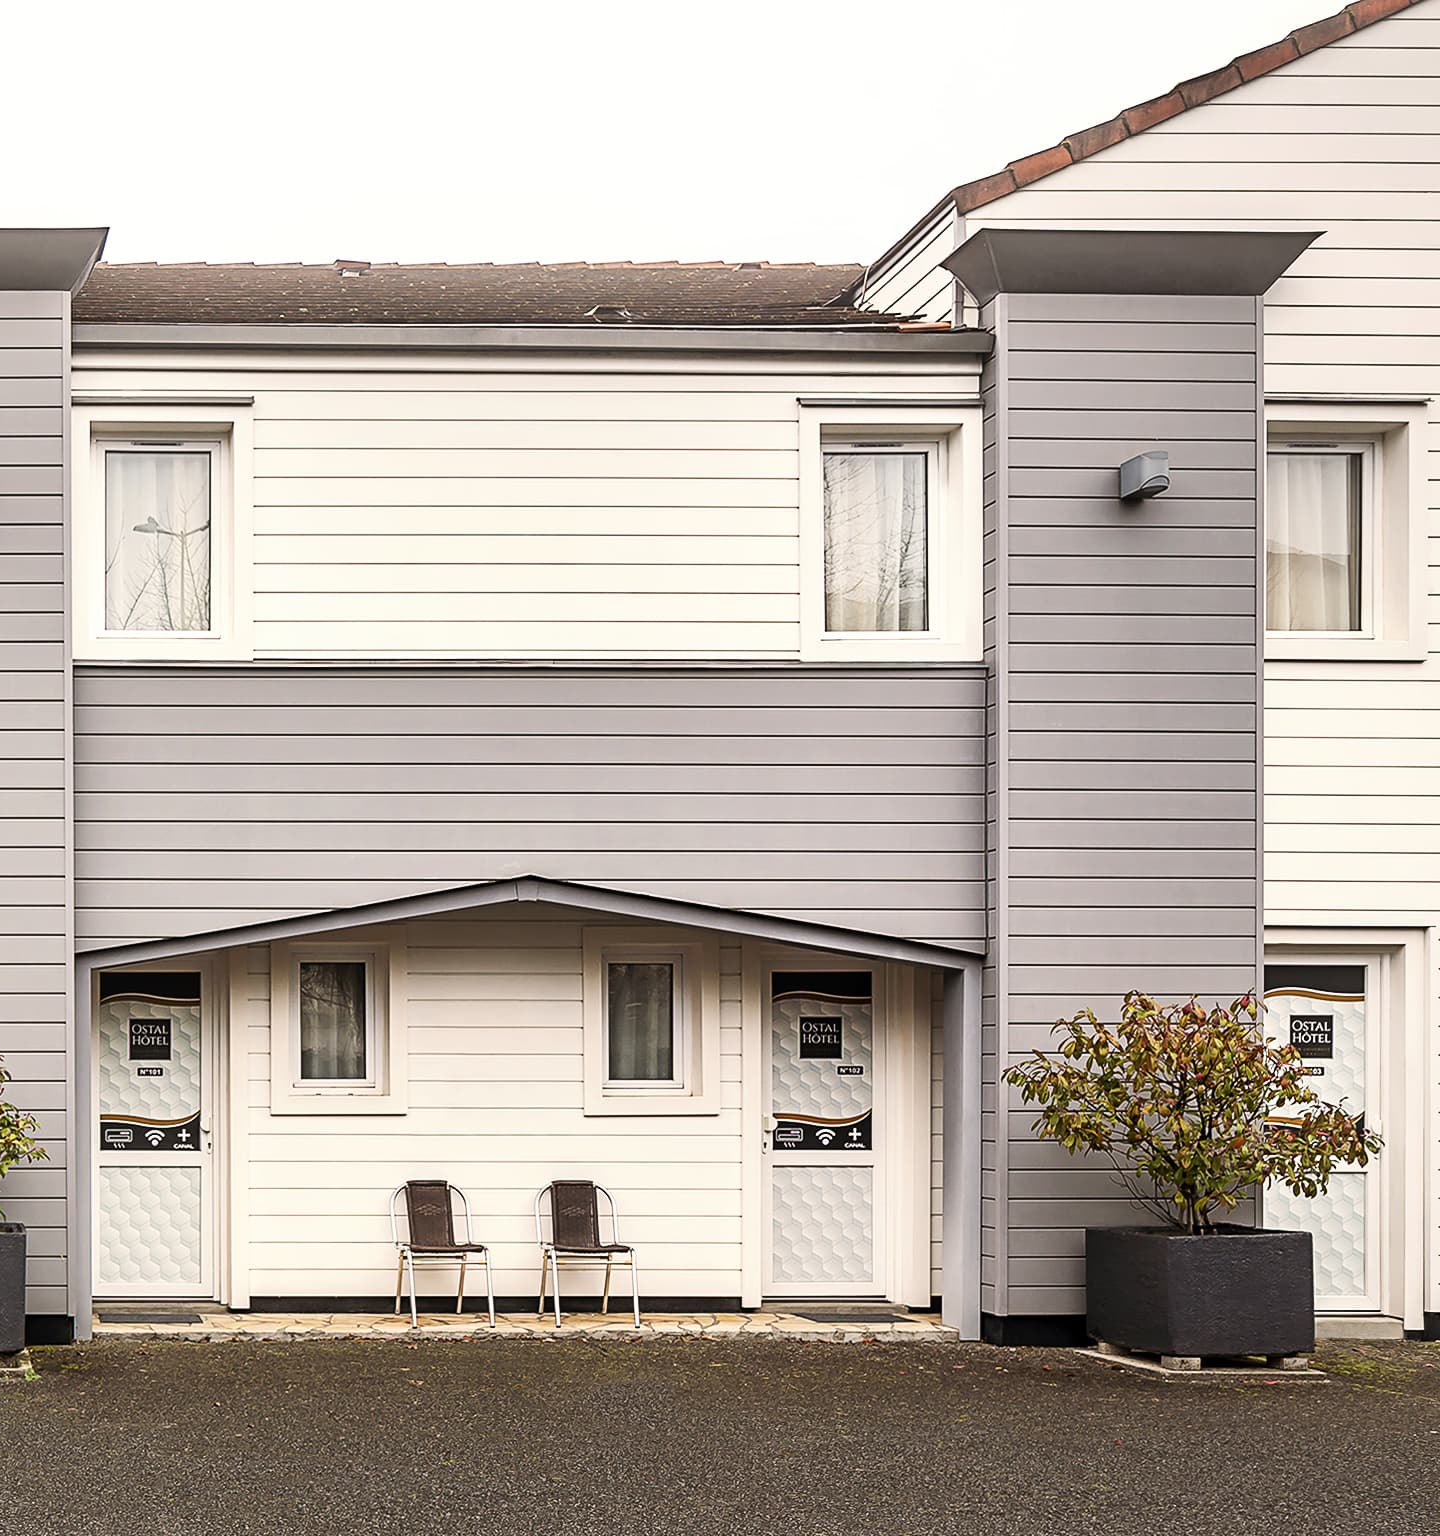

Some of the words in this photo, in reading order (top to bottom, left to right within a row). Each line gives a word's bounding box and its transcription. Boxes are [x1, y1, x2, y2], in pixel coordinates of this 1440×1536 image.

[131, 1024, 169, 1034] OSTAL
[802, 1022, 840, 1033] OSTAL
[1292, 1020, 1331, 1031] OSTAL
[132, 1035, 169, 1046] HÔTEL
[803, 1033, 840, 1044] HÔTEL
[1292, 1032, 1331, 1043] HÔTEL
